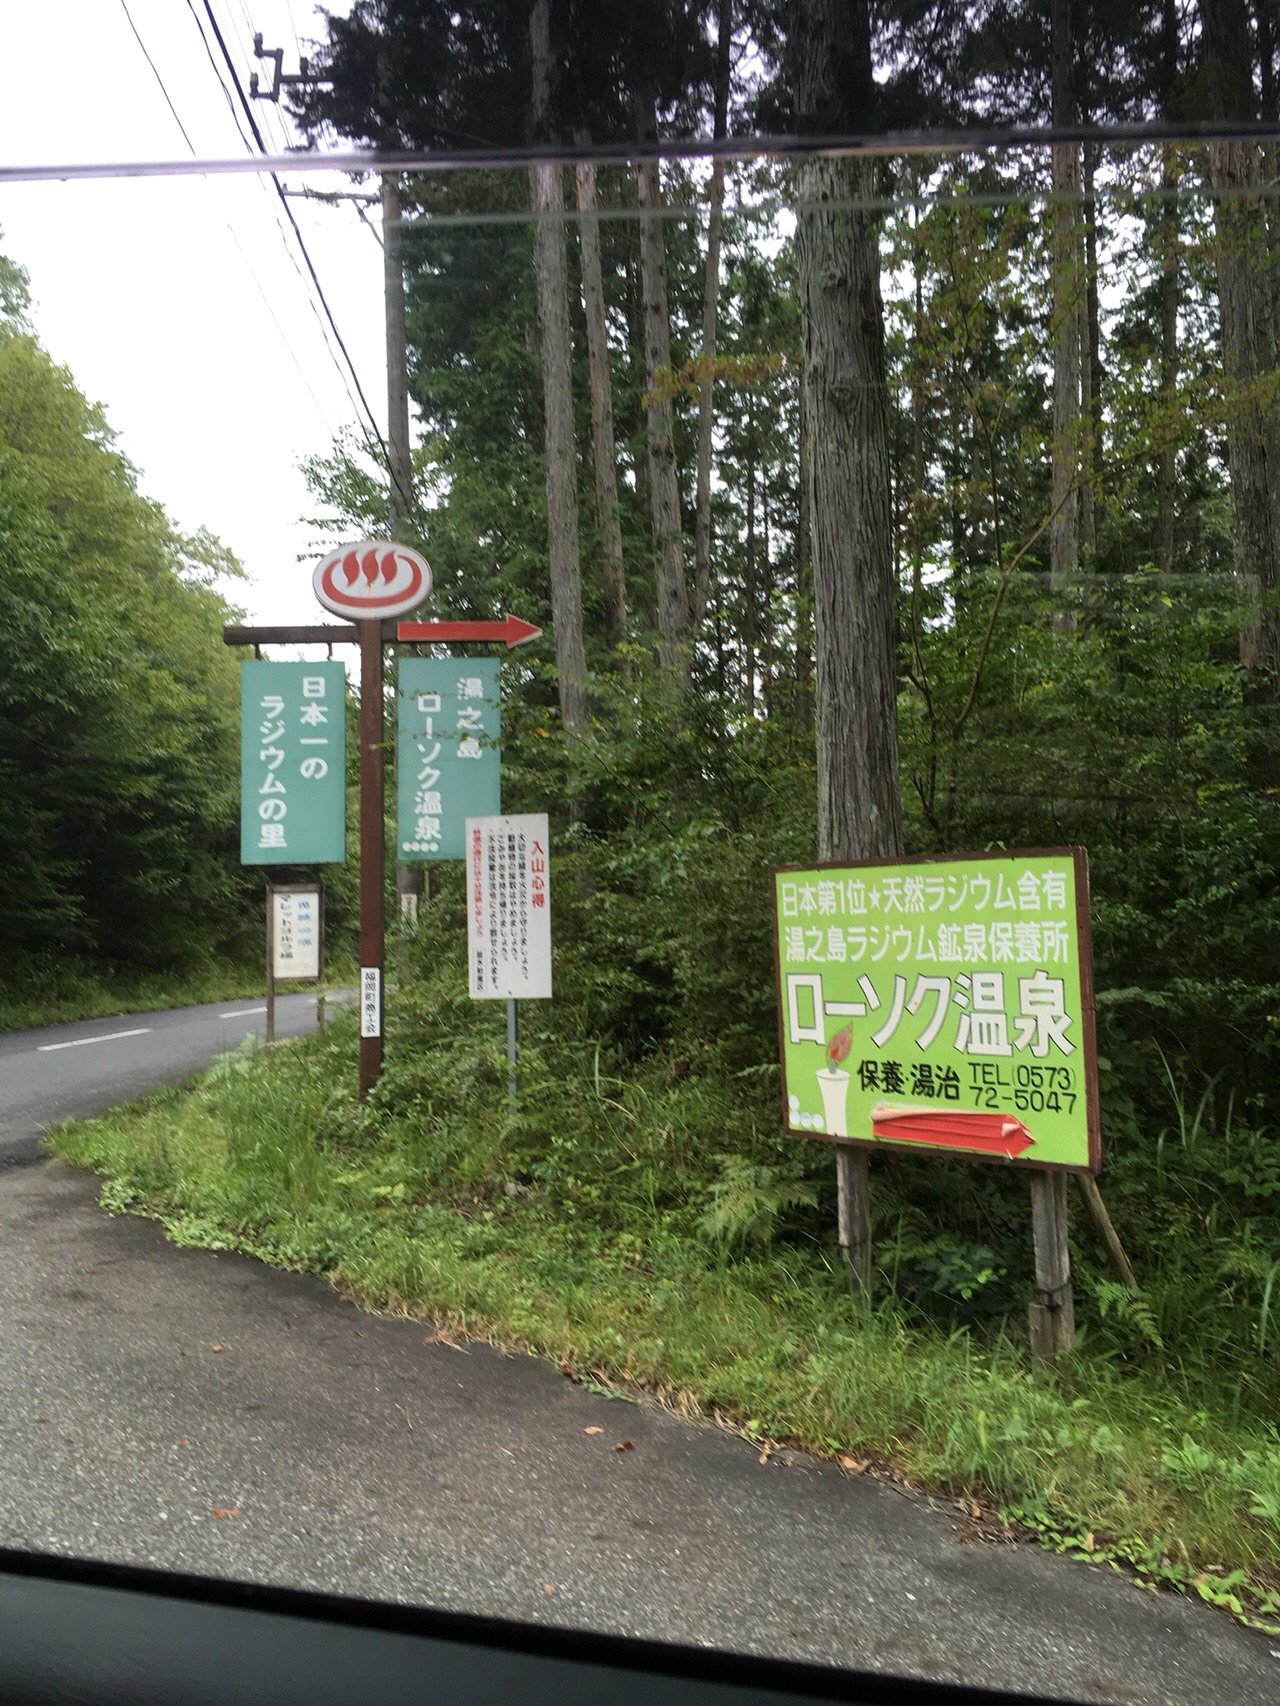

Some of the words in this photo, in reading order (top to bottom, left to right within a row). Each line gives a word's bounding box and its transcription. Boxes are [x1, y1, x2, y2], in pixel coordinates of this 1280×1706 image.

[300, 676, 329, 780] 日本一の
[457, 677, 484, 760] 湯之島
[258, 695, 288, 848] ラジウムの里
[414, 693, 442, 840] ローソク温泉
[530, 840, 546, 908] 入山心得
[784, 921, 1069, 963] 湯之島ラジウム鉱泉保養所
[786, 969, 1078, 1058] ローソク温泉
[970, 1085, 1077, 1115] 72-5047
